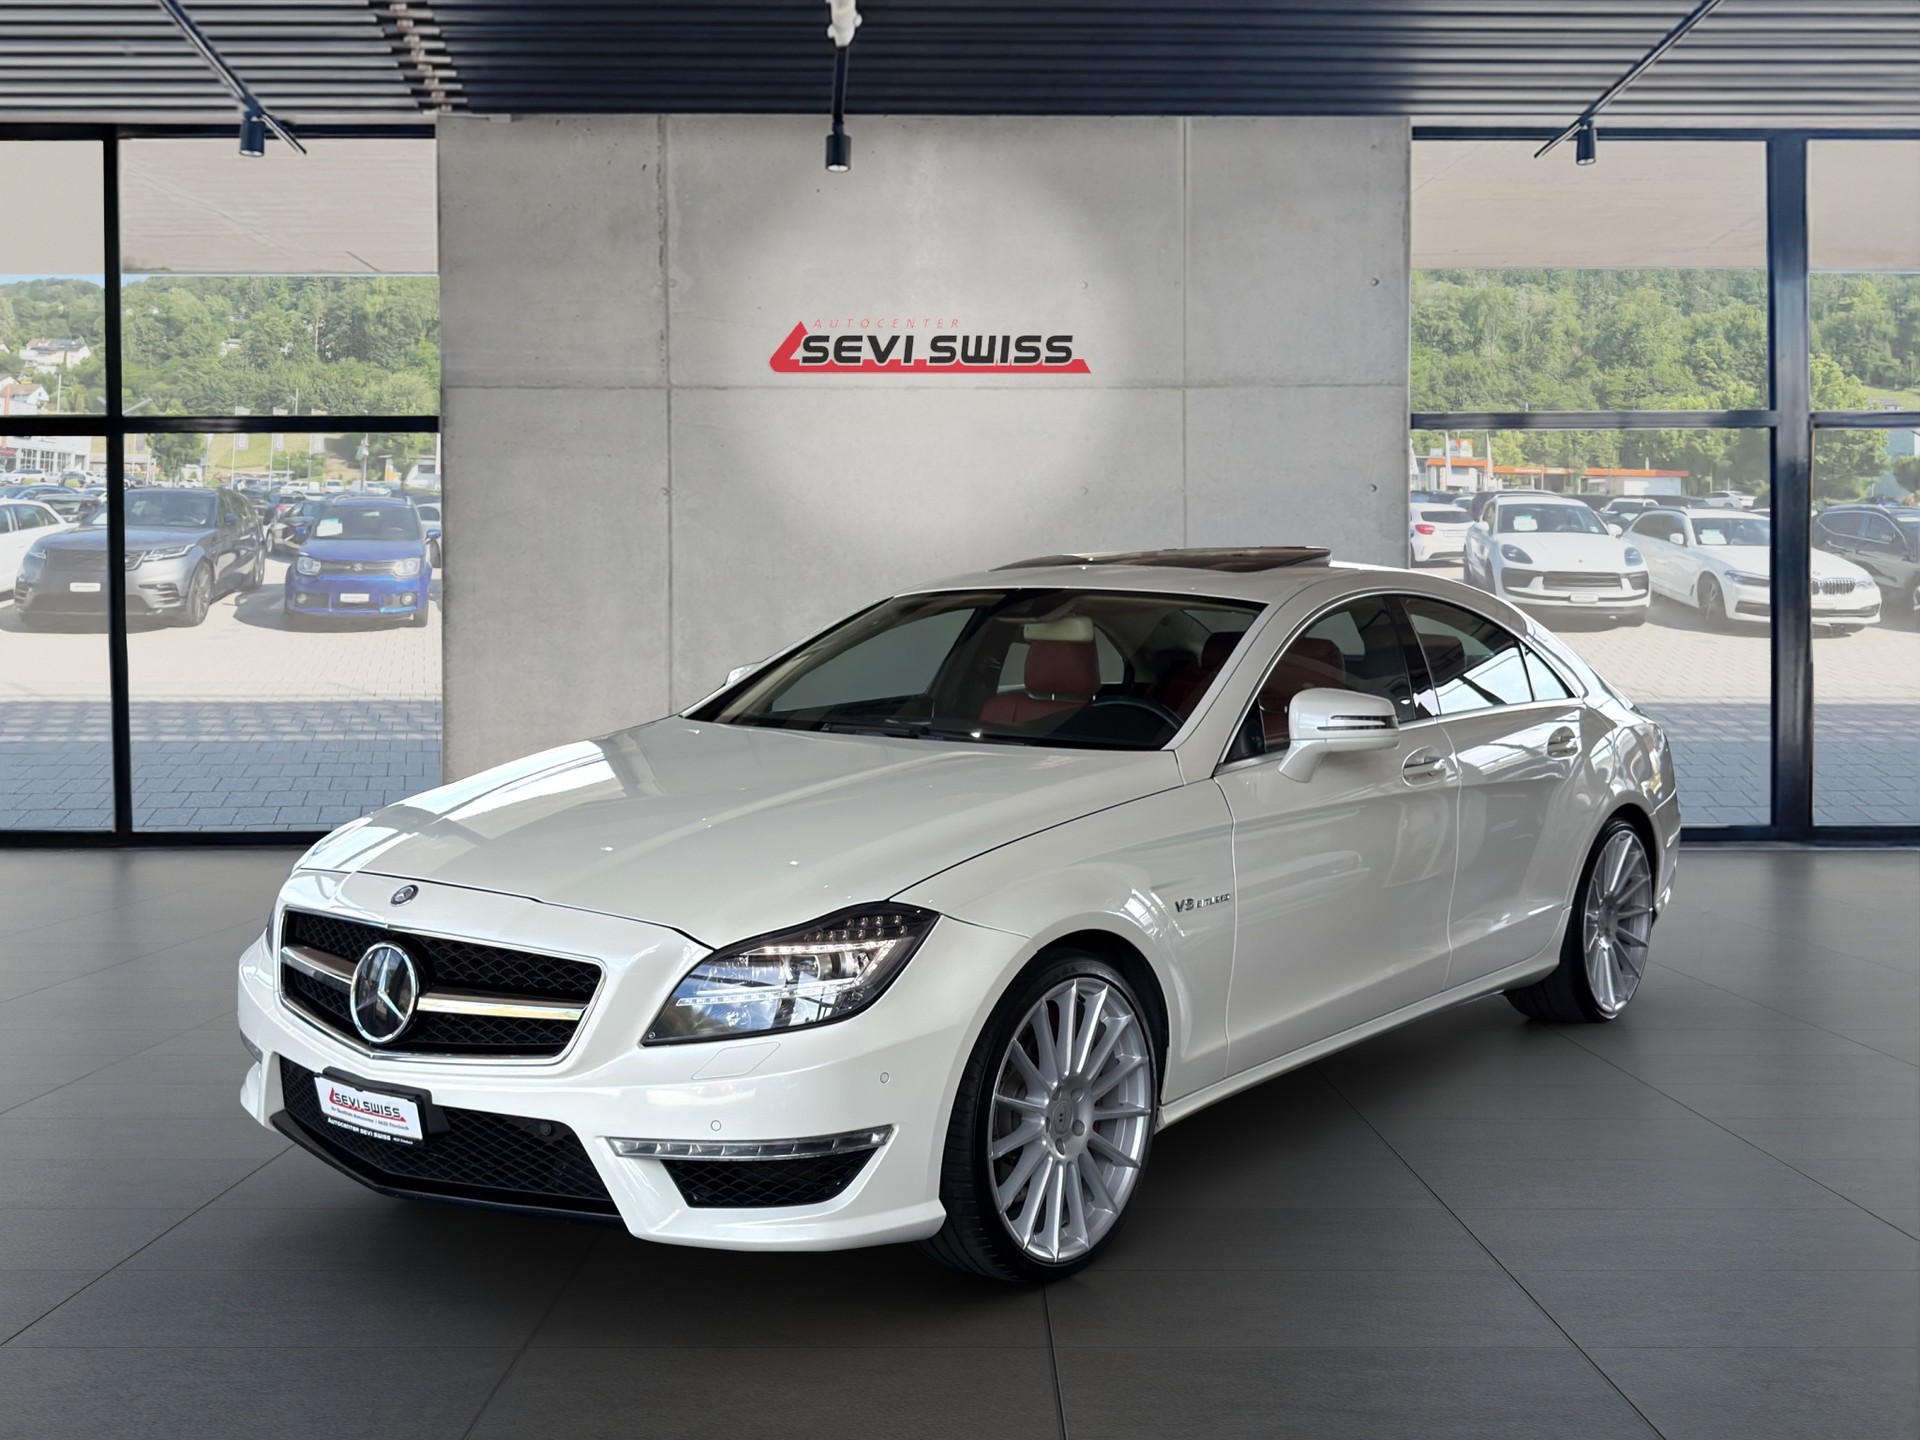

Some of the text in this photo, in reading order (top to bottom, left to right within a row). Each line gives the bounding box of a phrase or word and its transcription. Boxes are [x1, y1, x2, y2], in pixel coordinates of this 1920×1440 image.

[813, 318, 960, 329] AUTOCENTER
[802, 335, 1073, 364] SEVI SWISS
[334, 1092, 401, 1118] SEVI SWISS
